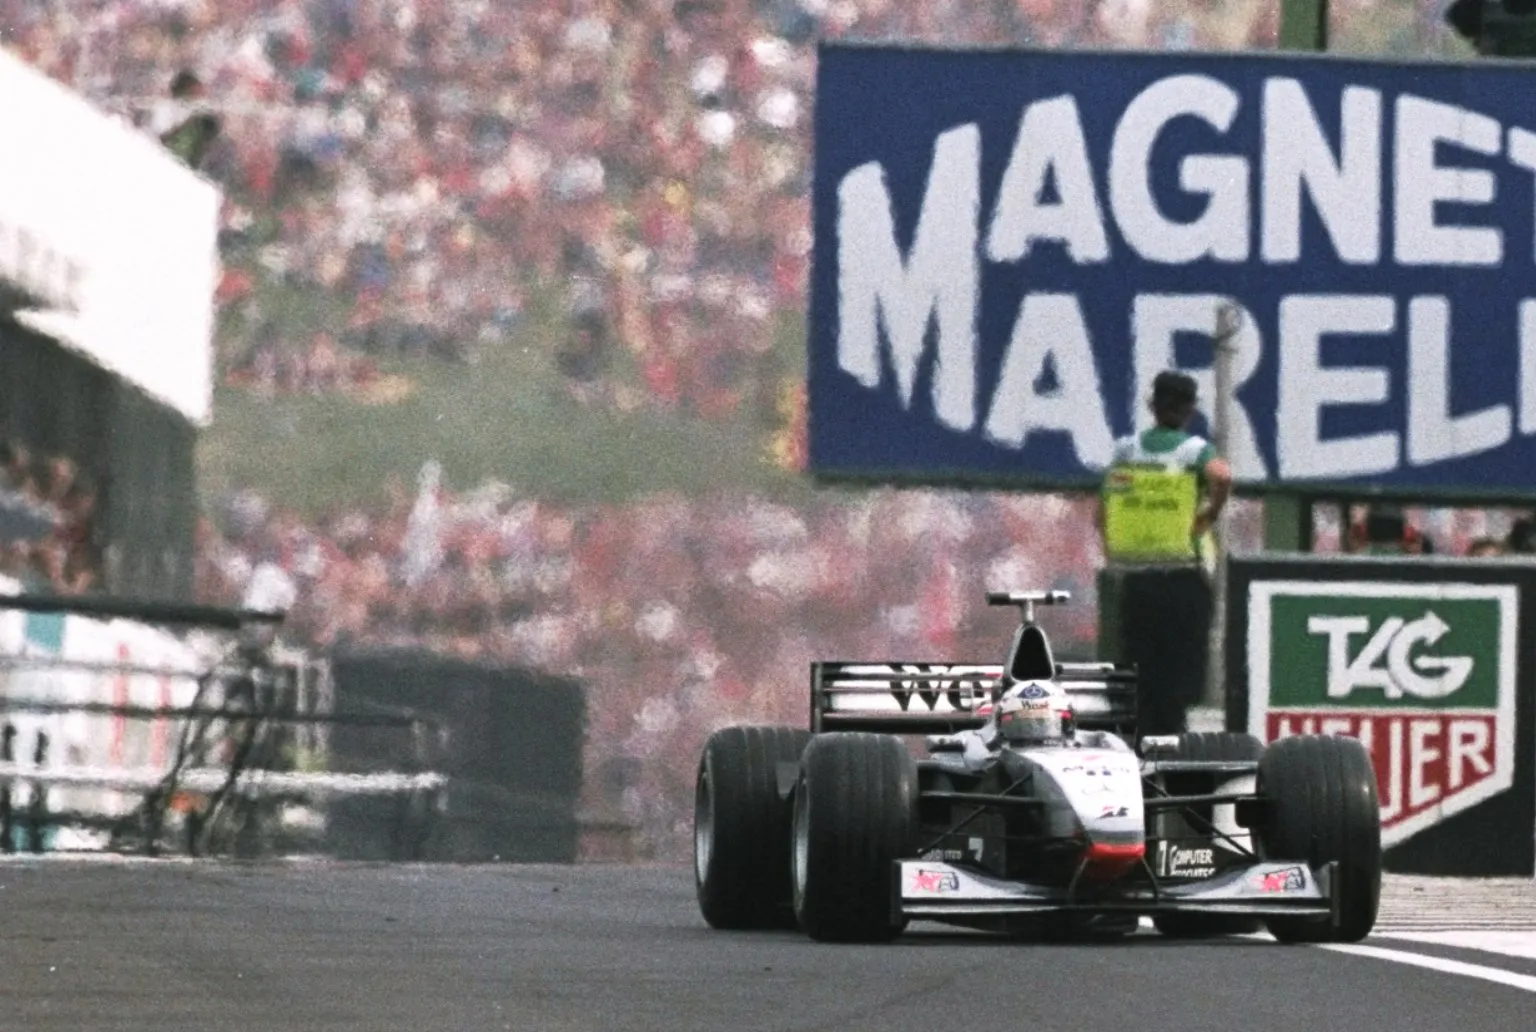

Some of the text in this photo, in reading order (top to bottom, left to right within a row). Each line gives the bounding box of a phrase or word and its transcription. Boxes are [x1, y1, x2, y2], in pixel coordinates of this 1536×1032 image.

[1307, 610, 1474, 699] TAG
[1278, 717, 1493, 823] UER
[1169, 845, 1214, 868] COMPUTER
